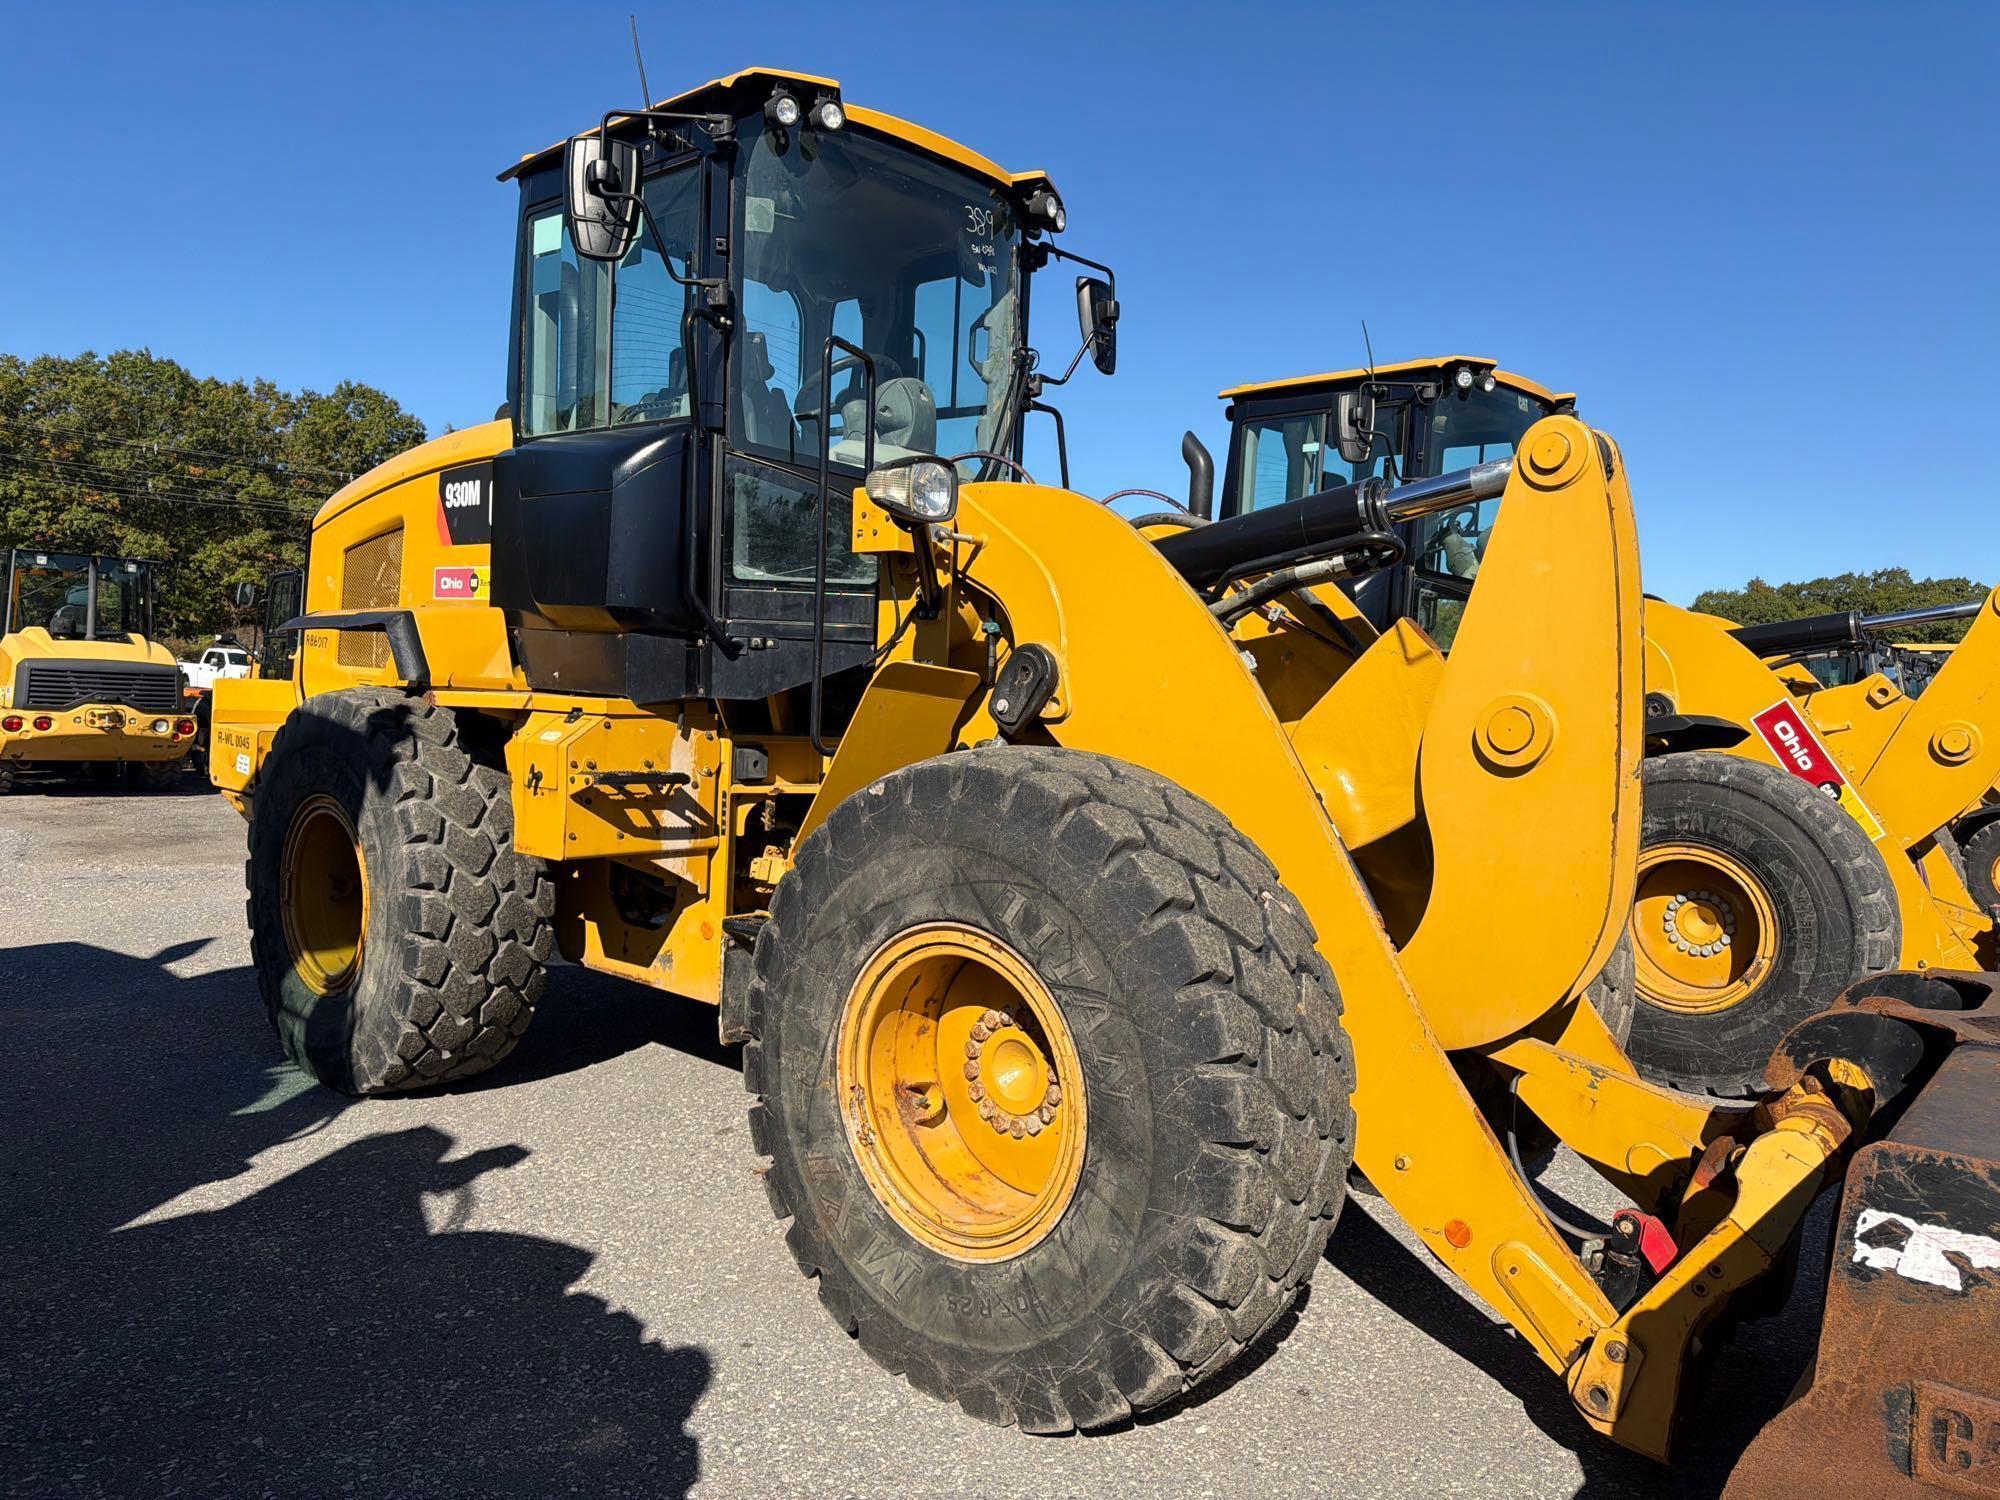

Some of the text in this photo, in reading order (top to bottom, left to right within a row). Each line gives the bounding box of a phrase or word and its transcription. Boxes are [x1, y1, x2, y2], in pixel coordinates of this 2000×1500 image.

[965, 205, 994, 240] 389
[445, 480, 481, 508] 930M
[440, 576, 463, 590] Ohio
[235, 734, 250, 750] 0045
[1773, 720, 1813, 771] Ohio
[1819, 783, 1838, 800] CAT
